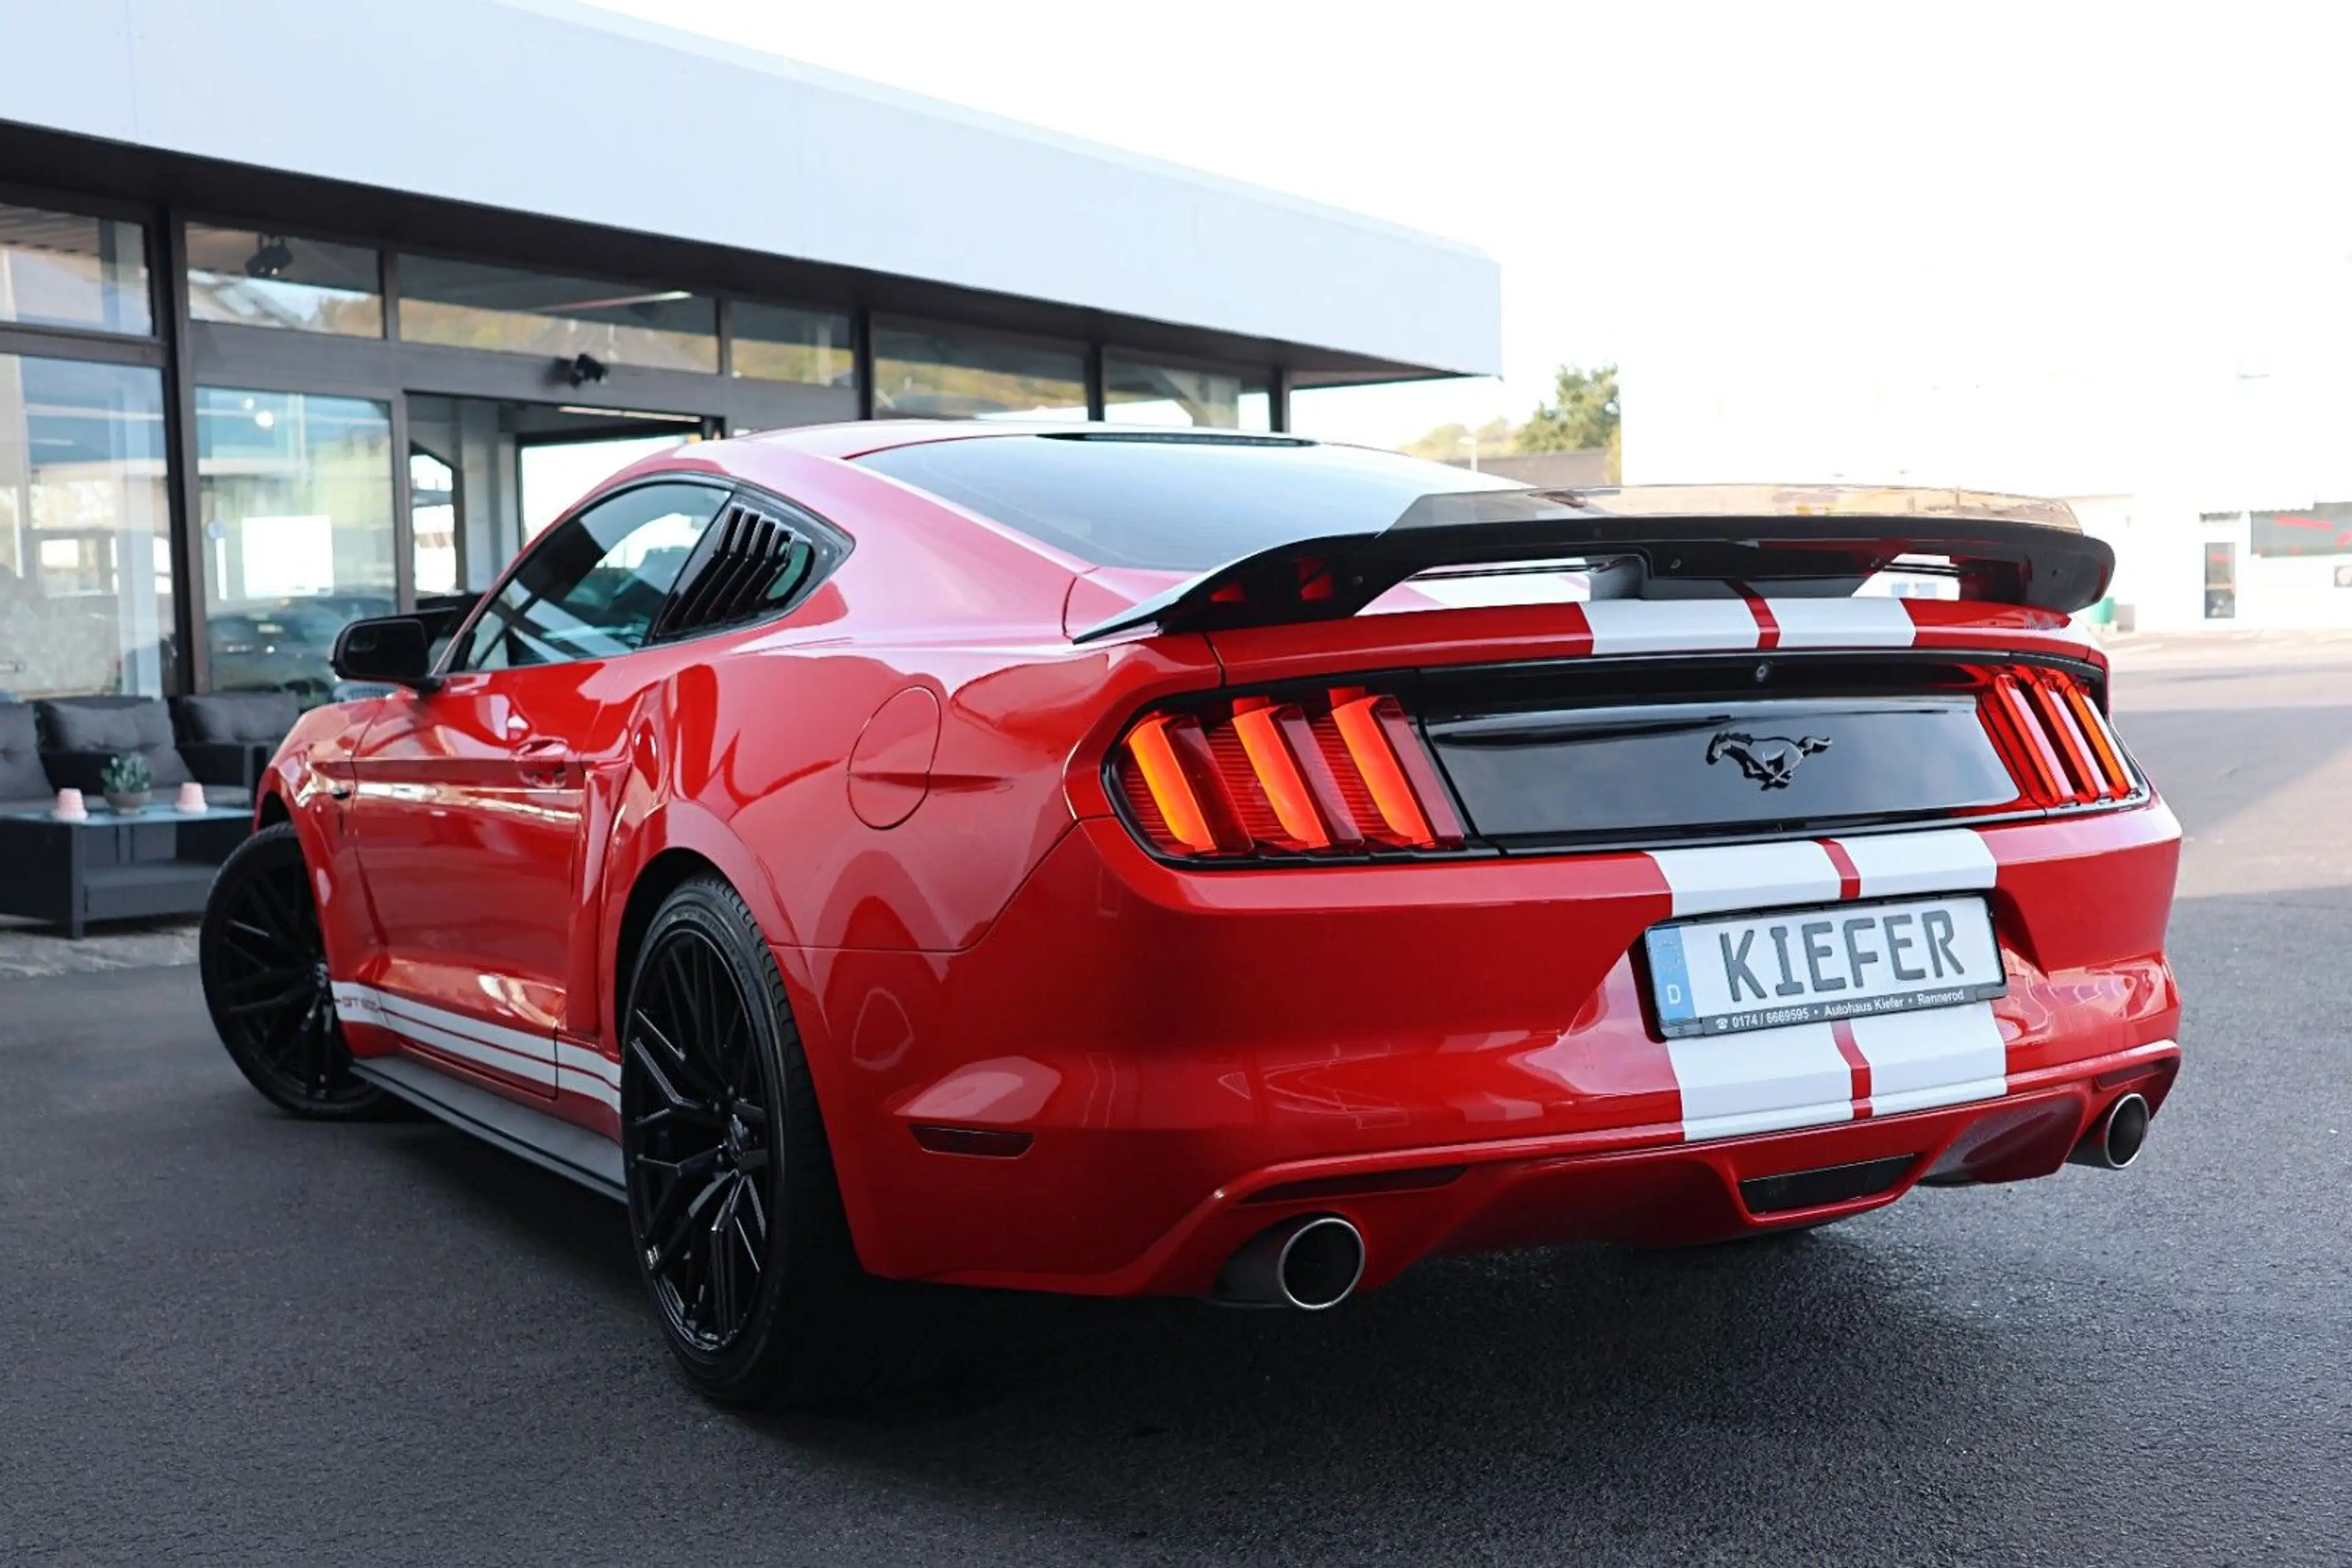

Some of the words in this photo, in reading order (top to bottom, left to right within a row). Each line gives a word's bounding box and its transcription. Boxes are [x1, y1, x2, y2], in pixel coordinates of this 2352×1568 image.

[1719, 909, 1965, 1003] KIEFER
[1667, 984, 1681, 1005] D
[1732, 1014, 1758, 1028] 0174
[1824, 1000, 1872, 1017] Autohaus
[1874, 997, 1904, 1011] Kiefer
